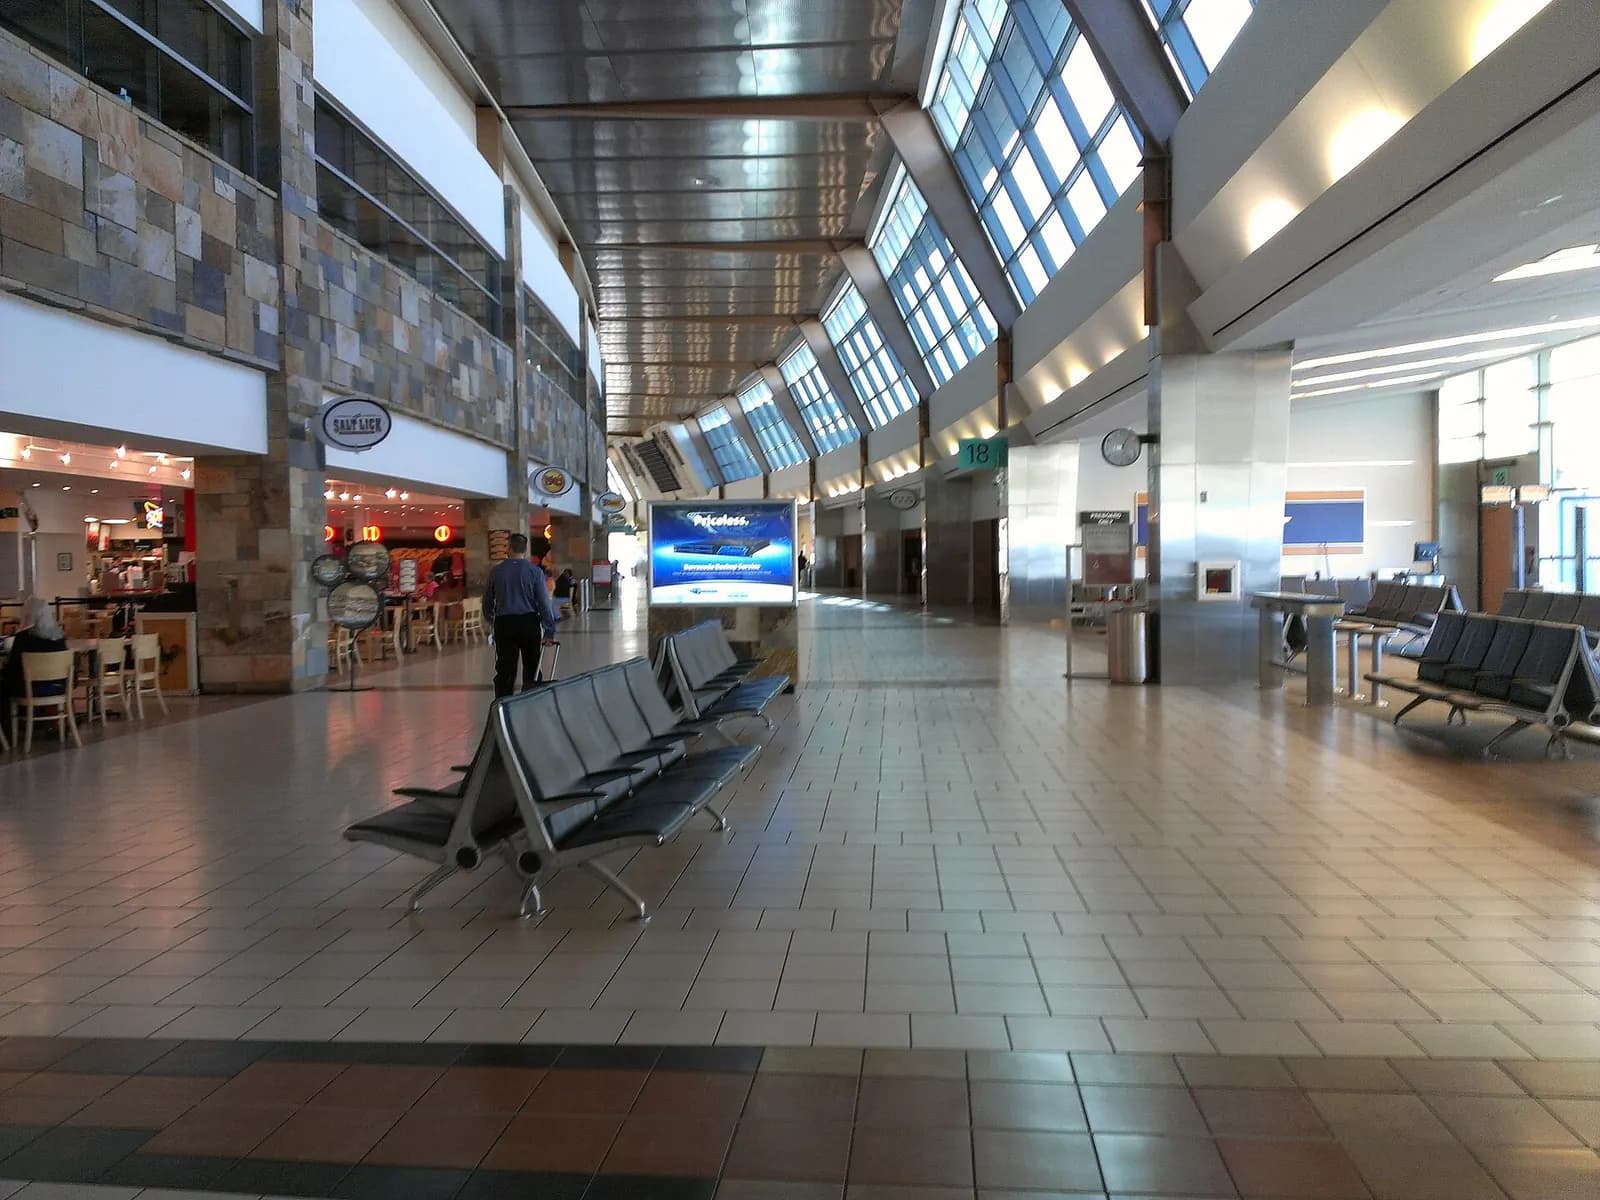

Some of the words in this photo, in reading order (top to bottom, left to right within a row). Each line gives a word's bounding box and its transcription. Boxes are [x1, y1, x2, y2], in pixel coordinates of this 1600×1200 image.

[333, 418, 357, 433] SALT
[359, 417, 382, 432] LICK
[967, 443, 989, 464] 18
